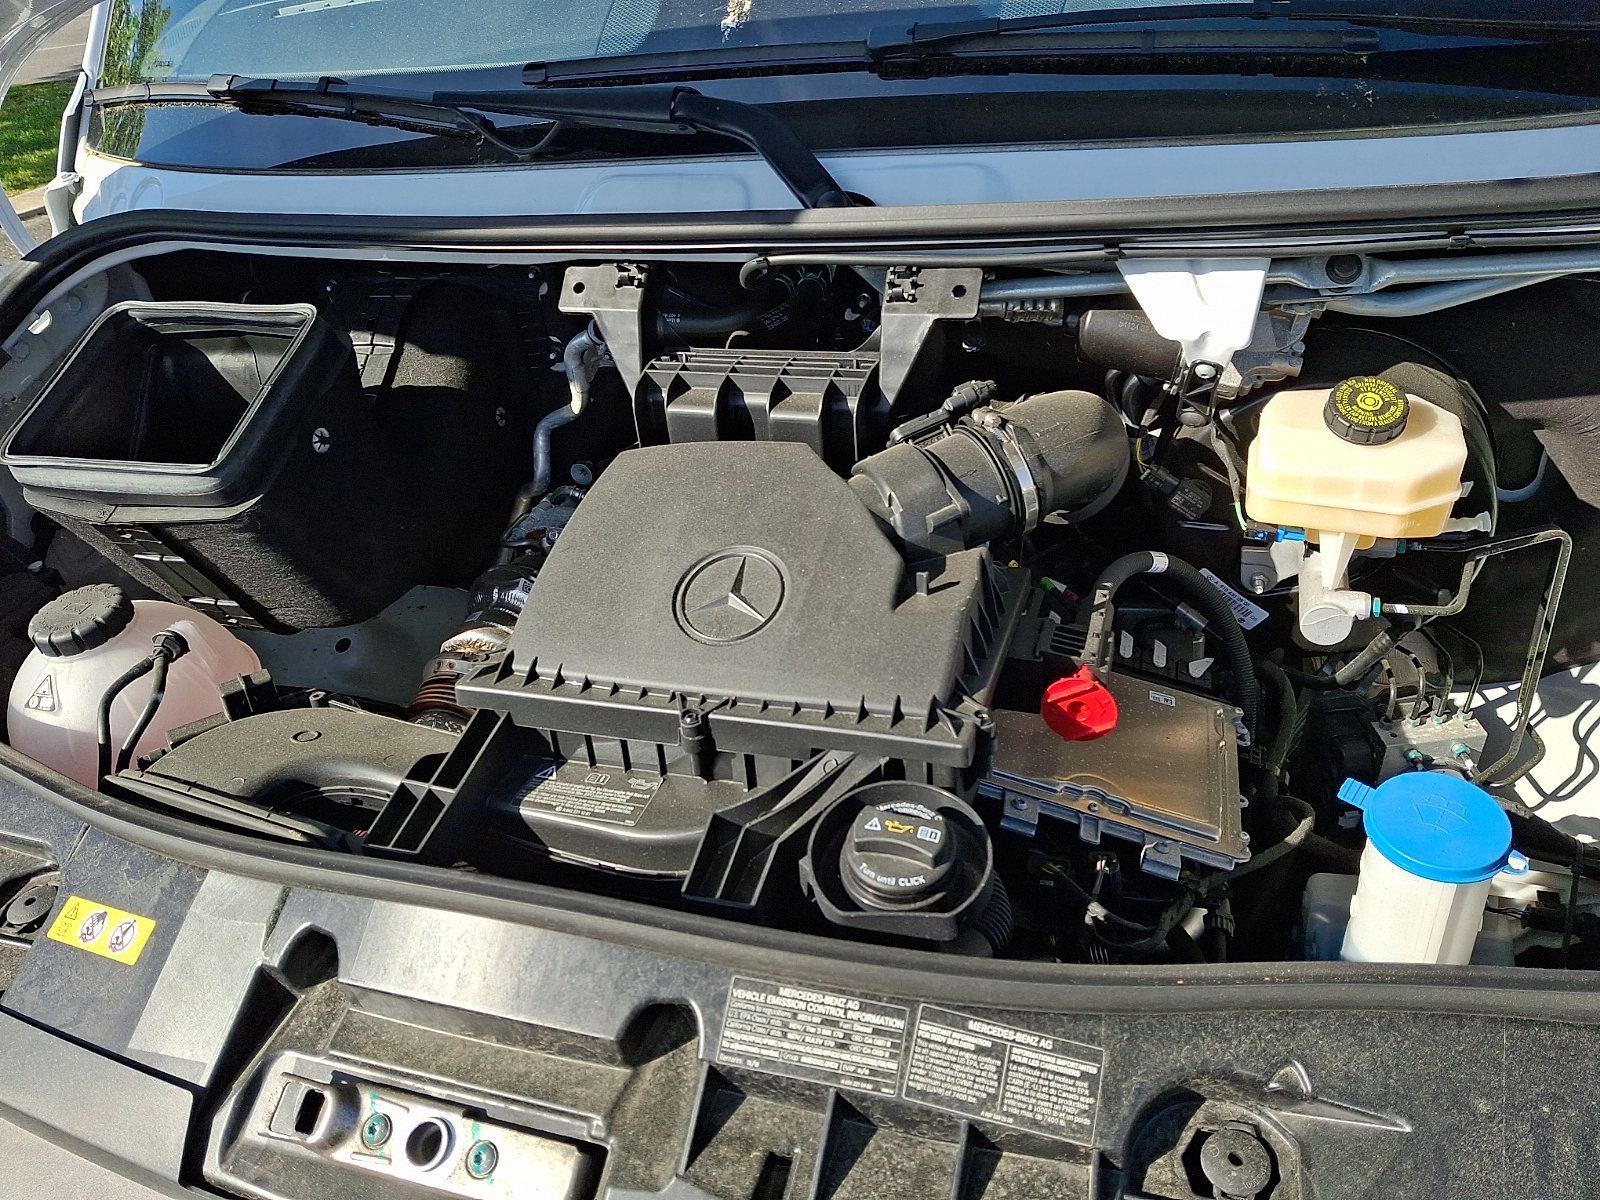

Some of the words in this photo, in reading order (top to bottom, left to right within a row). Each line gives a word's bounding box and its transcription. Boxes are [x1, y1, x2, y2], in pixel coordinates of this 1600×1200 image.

[860, 862, 875, 879] Turn
[876, 875, 895, 886] until
[898, 875, 925, 887] CLICK
[778, 986, 847, 1007] MERCEDES-BENZ
[732, 988, 766, 1003] VEHICLE
[766, 994, 806, 1010] EMISSION
[806, 1002, 846, 1018] CONTROL
[846, 1010, 904, 1029] INFORMATION
[918, 1024, 951, 1037] IMPORTANT
[952, 1032, 992, 1047] INFORMATION
[930, 1034, 946, 1043] BODY
[946, 1038, 975, 1050] BUILDERS
[968, 1020, 1039, 1046] MERCEDES-BENZ
[978, 1054, 1001, 1066] conform
[1010, 1054, 1028, 1064] POUR
[1012, 1046, 1056, 1064] INFORMATIONS
[1056, 1058, 1097, 1074] IMPORTANTES
[1054, 1074, 1074, 1085] moteur
[1074, 1080, 1089, 1088] sont
[1058, 1090, 1079, 1100] Canada
